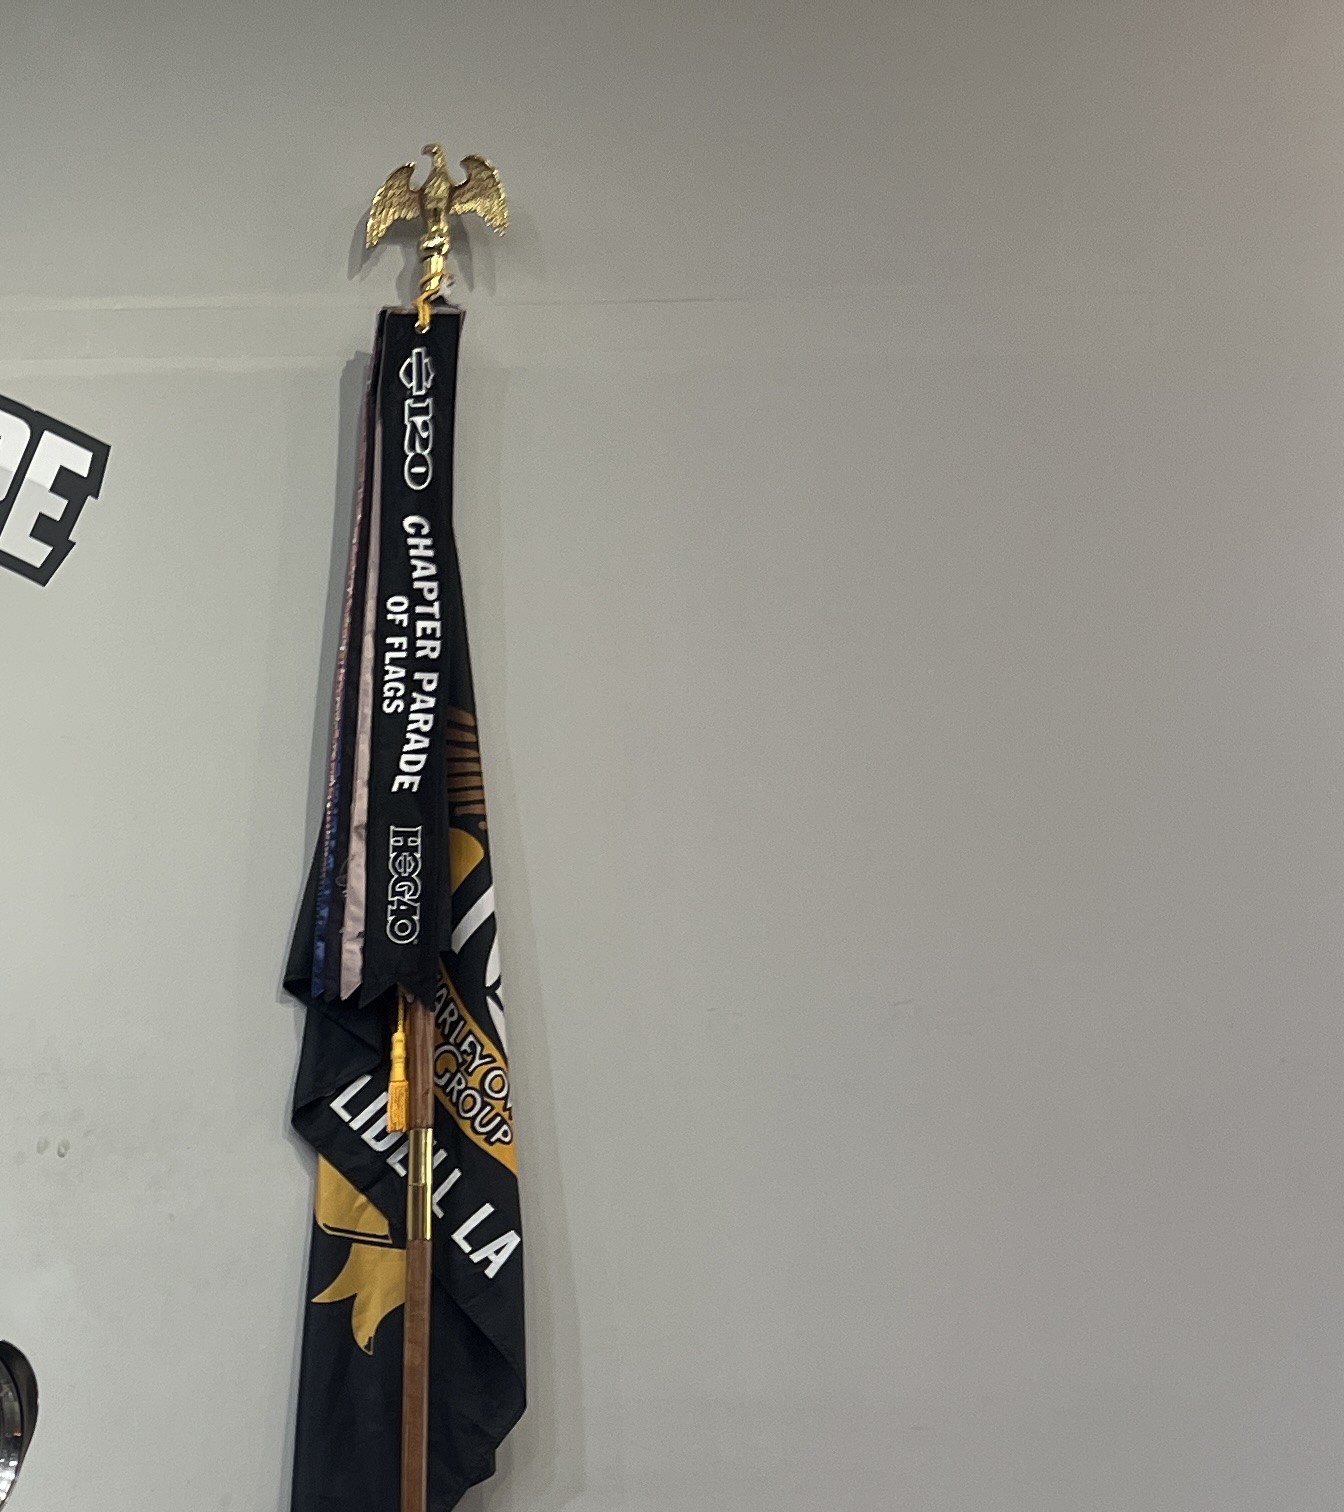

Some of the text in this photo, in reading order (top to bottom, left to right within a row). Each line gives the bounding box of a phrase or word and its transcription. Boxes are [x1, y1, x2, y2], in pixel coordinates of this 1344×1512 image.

[382, 595, 409, 714] OF FLAGS
[391, 515, 443, 794] CHAPTER PARADE
[433, 978, 495, 1075] ARLEY
[434, 1044, 512, 1144] GROUP
[451, 1202, 521, 1279] LA
